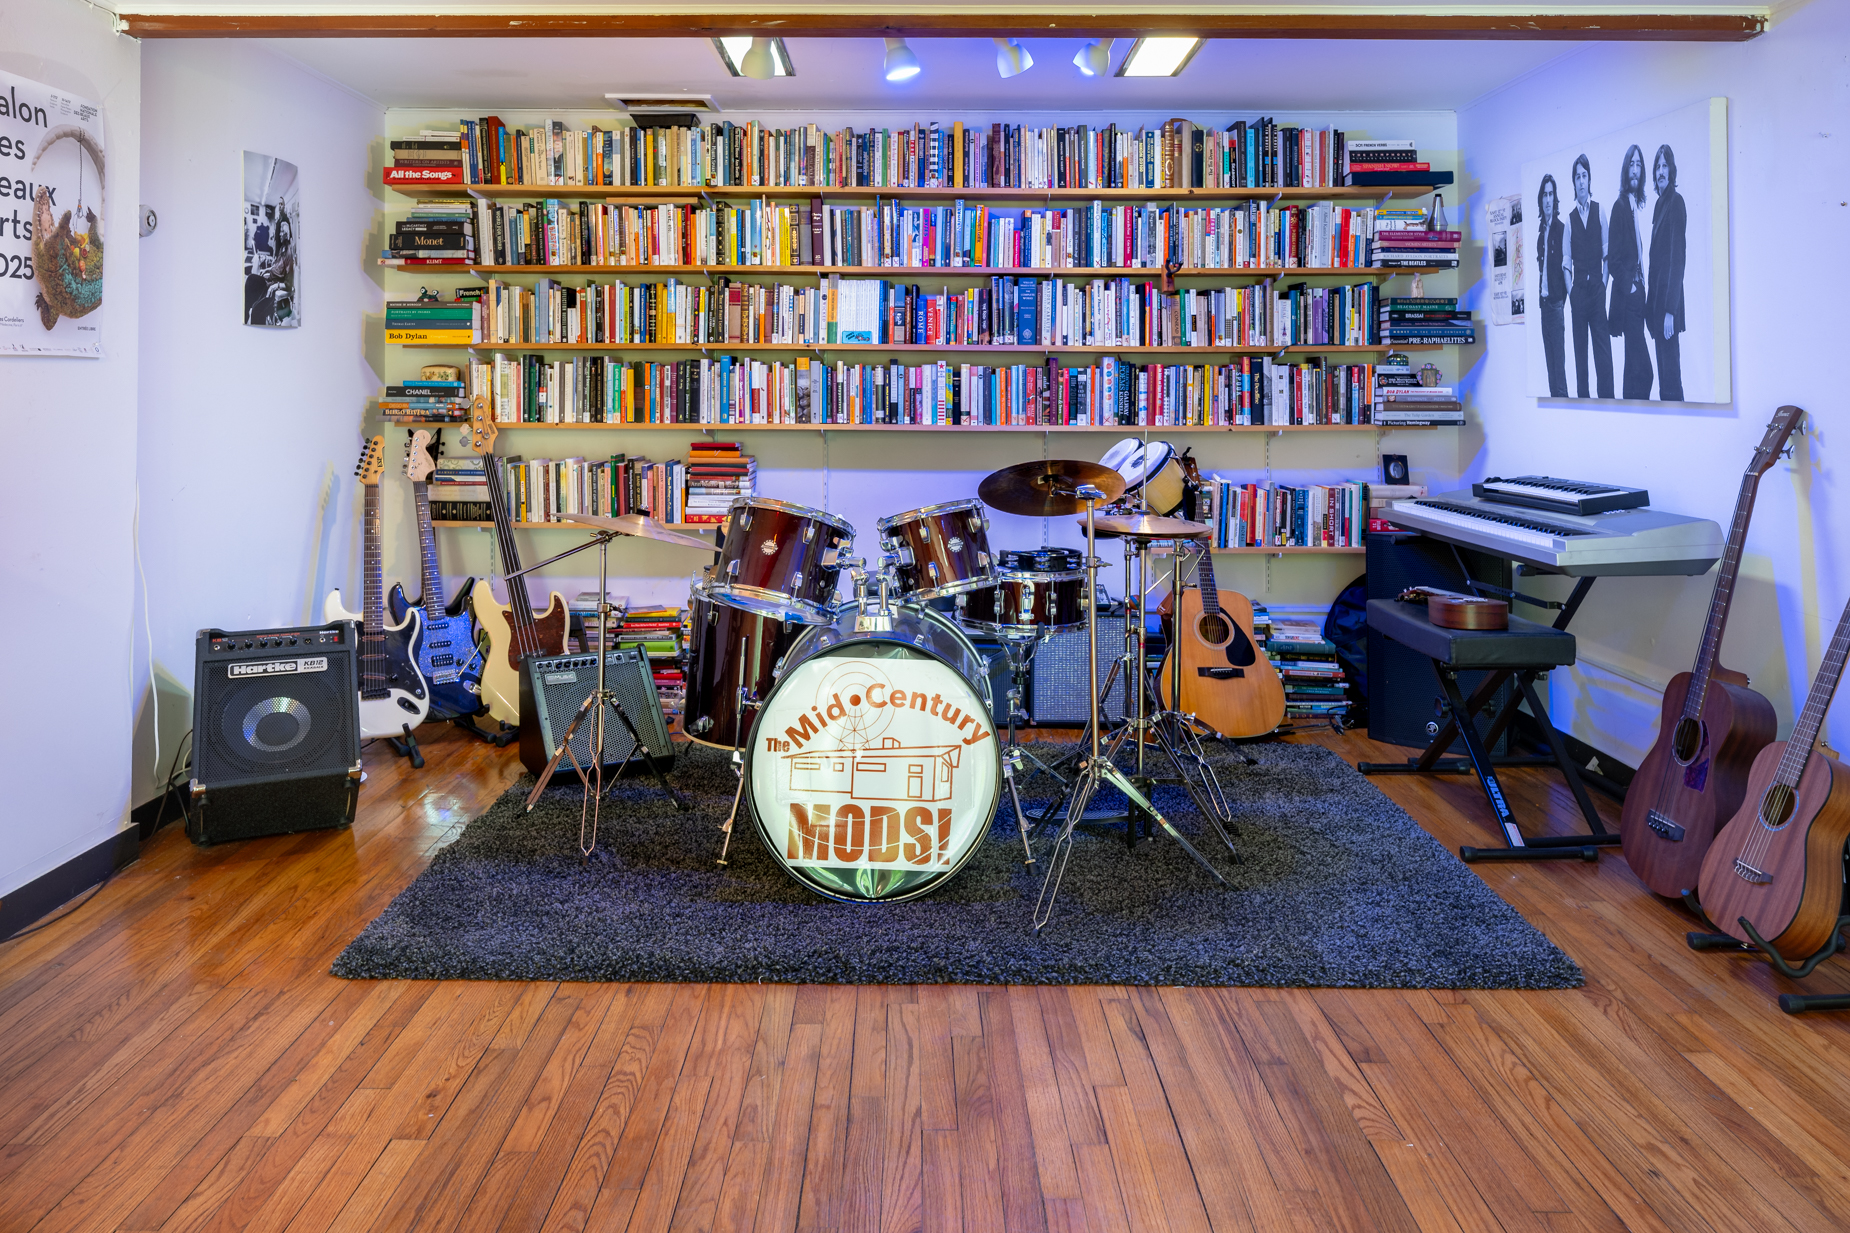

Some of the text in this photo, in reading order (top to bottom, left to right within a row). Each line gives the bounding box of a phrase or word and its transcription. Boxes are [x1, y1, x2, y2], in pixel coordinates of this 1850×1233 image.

[390, 170, 452, 180] All the Songs
[414, 236, 444, 246] Monet
[459, 289, 480, 297] French
[405, 333, 428, 341] Dylan
[1329, 497, 1335, 507] IN
[233, 662, 297, 675] Hartke
[766, 683, 989, 753] The Mid Century
[787, 803, 951, 865] MODS!
